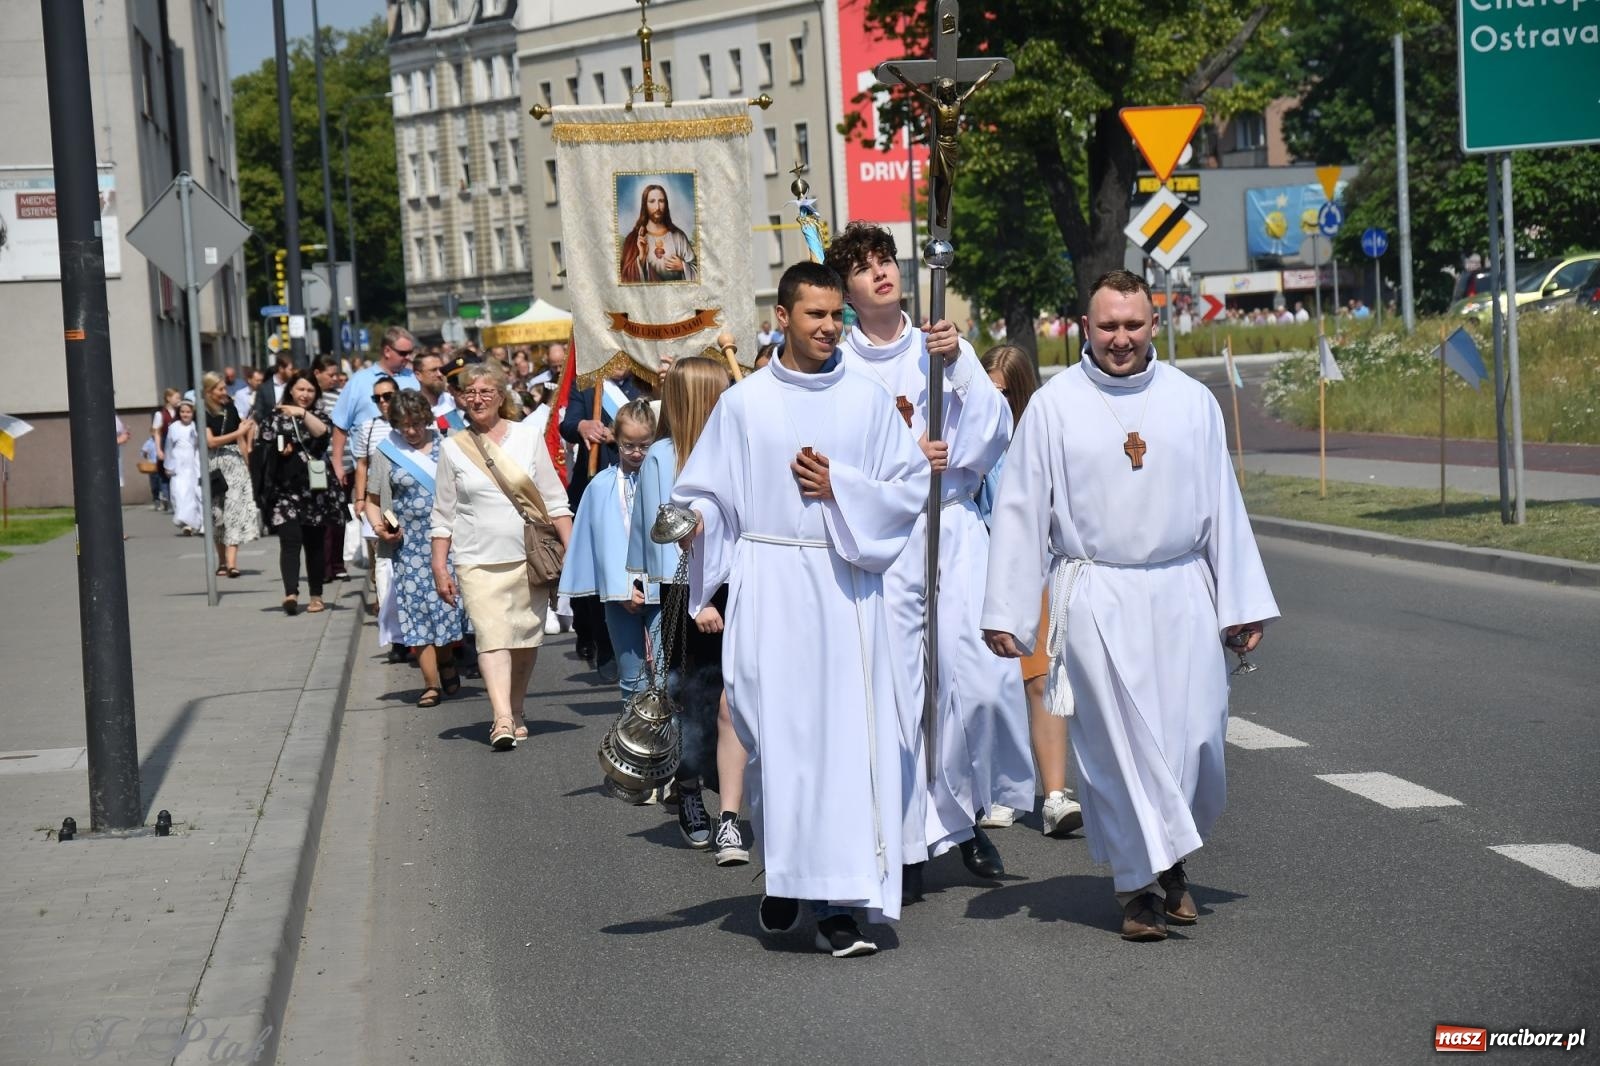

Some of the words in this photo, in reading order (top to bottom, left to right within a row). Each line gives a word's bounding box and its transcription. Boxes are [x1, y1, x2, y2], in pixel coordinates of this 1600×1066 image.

[1470, 23, 1600, 53] Ostrava
[860, 160, 922, 182] DRIVE
[20, 194, 56, 206] MEDYC
[20, 206, 57, 217] ESTETYC
